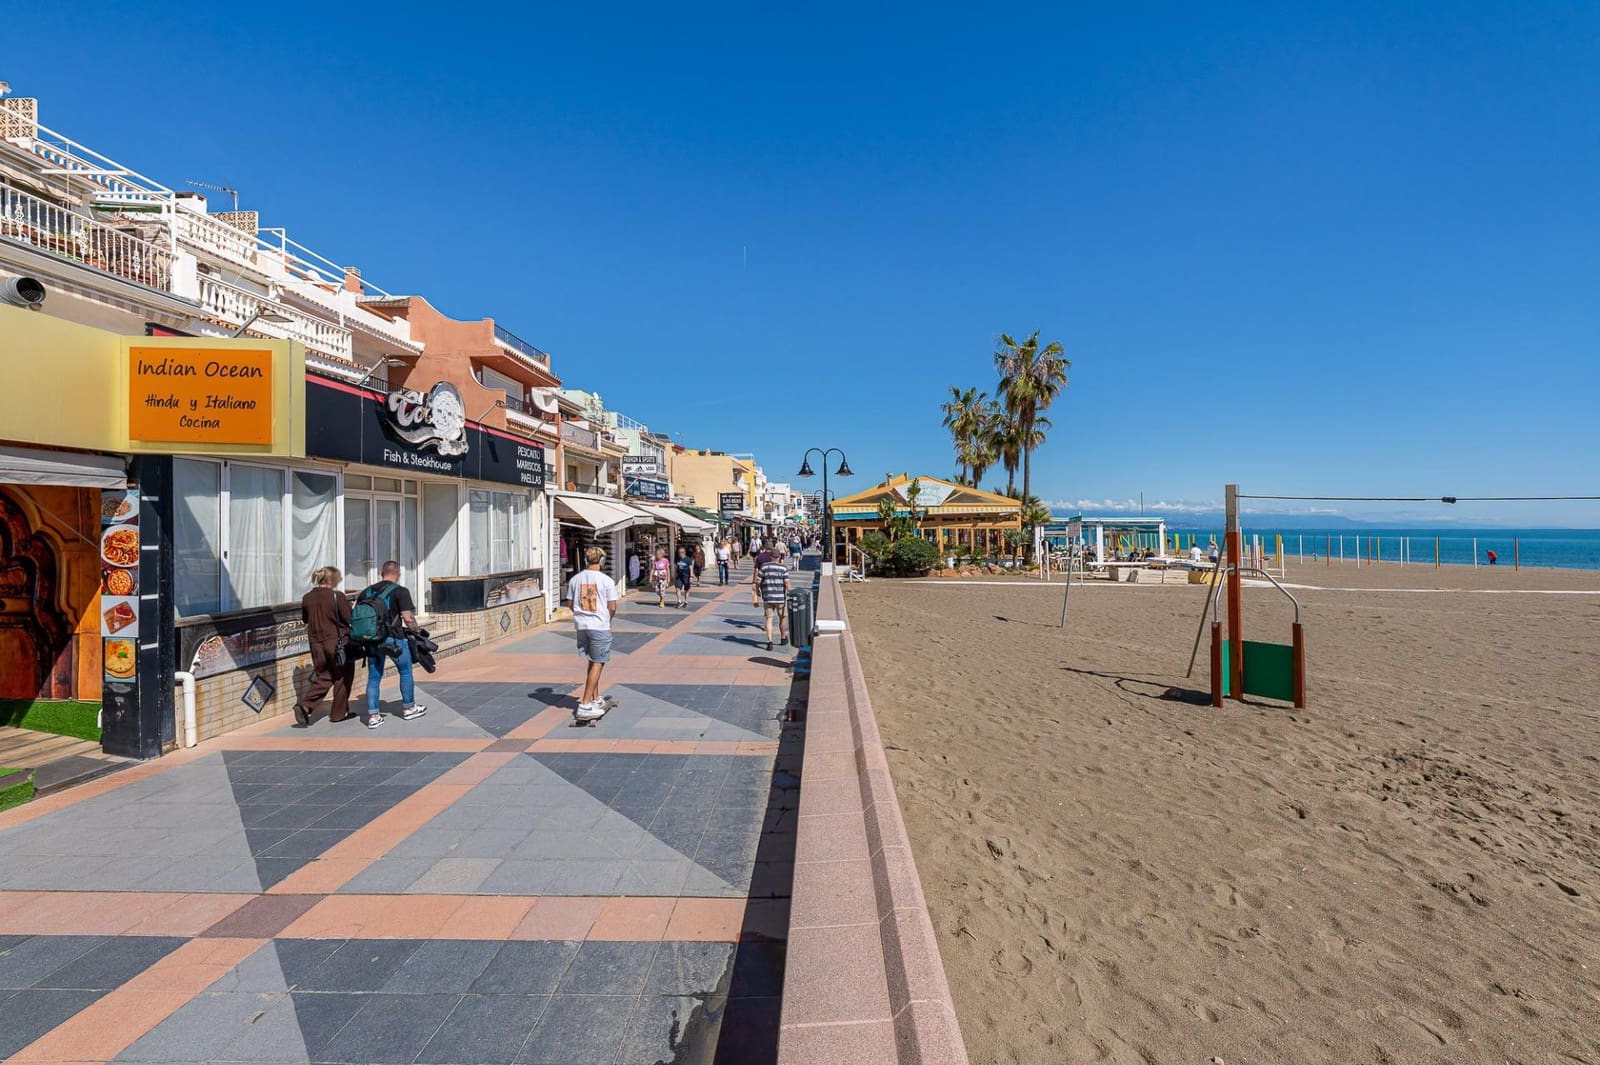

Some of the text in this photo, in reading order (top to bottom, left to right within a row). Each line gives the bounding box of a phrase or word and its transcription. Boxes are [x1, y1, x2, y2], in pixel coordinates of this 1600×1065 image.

[137, 358, 263, 378] Indian Ocean
[145, 393, 257, 411] Hindu y Italiano
[179, 415, 220, 429] Cocina
[383, 448, 452, 471] Fish & Steakhouse
[517, 445, 541, 460] PESCAITO
[516, 458, 542, 473] MARISCOS
[520, 472, 542, 485] PAELLAS
